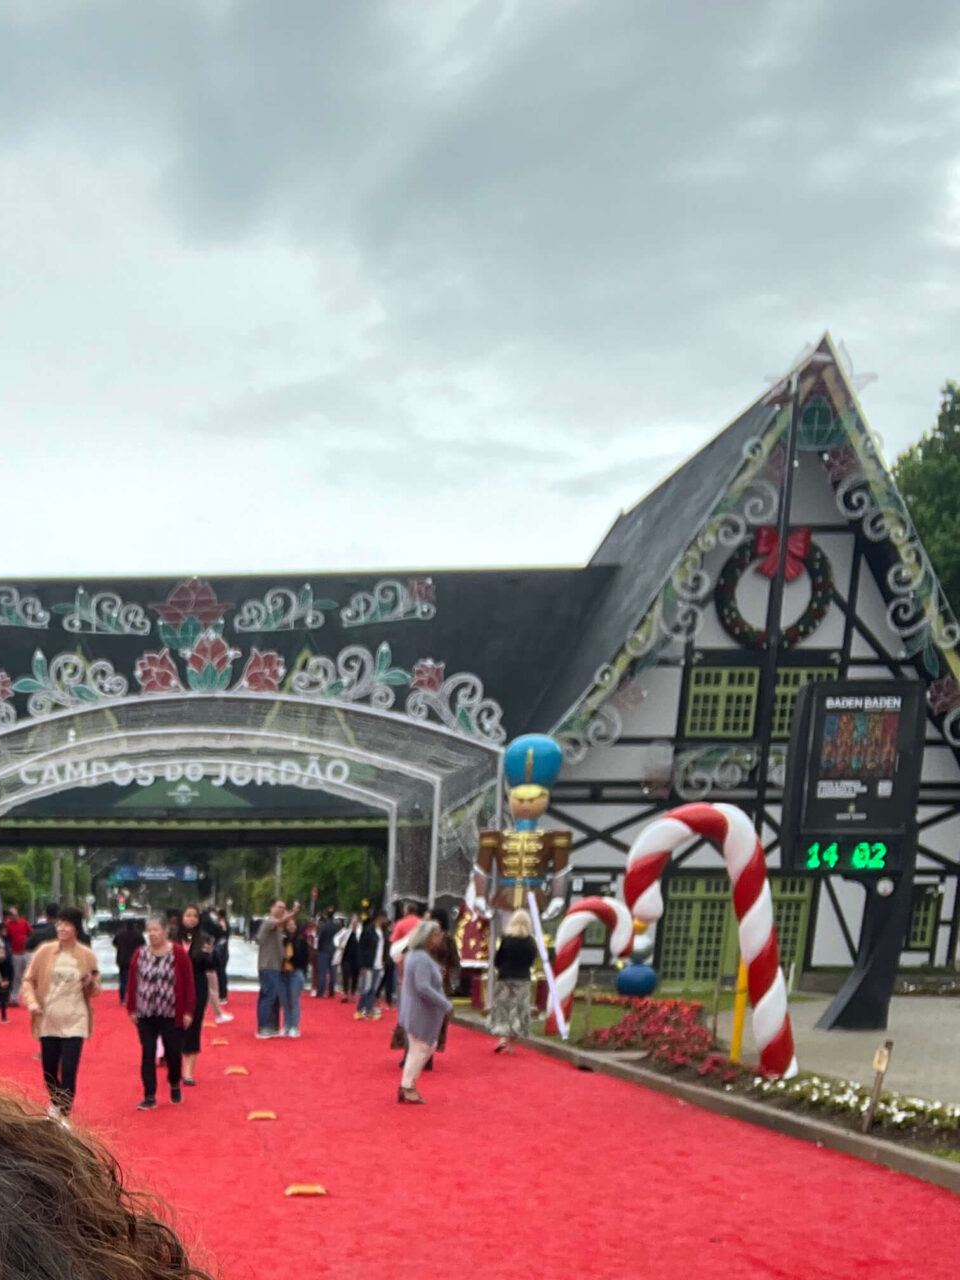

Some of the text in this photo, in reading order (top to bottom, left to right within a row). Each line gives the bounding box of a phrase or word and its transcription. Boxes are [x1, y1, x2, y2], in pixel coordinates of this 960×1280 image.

[825, 696, 901, 709] BADEN BADEN
[18, 756, 350, 786] CAMPOS DO JORDÃO
[806, 842, 839, 869] 14
